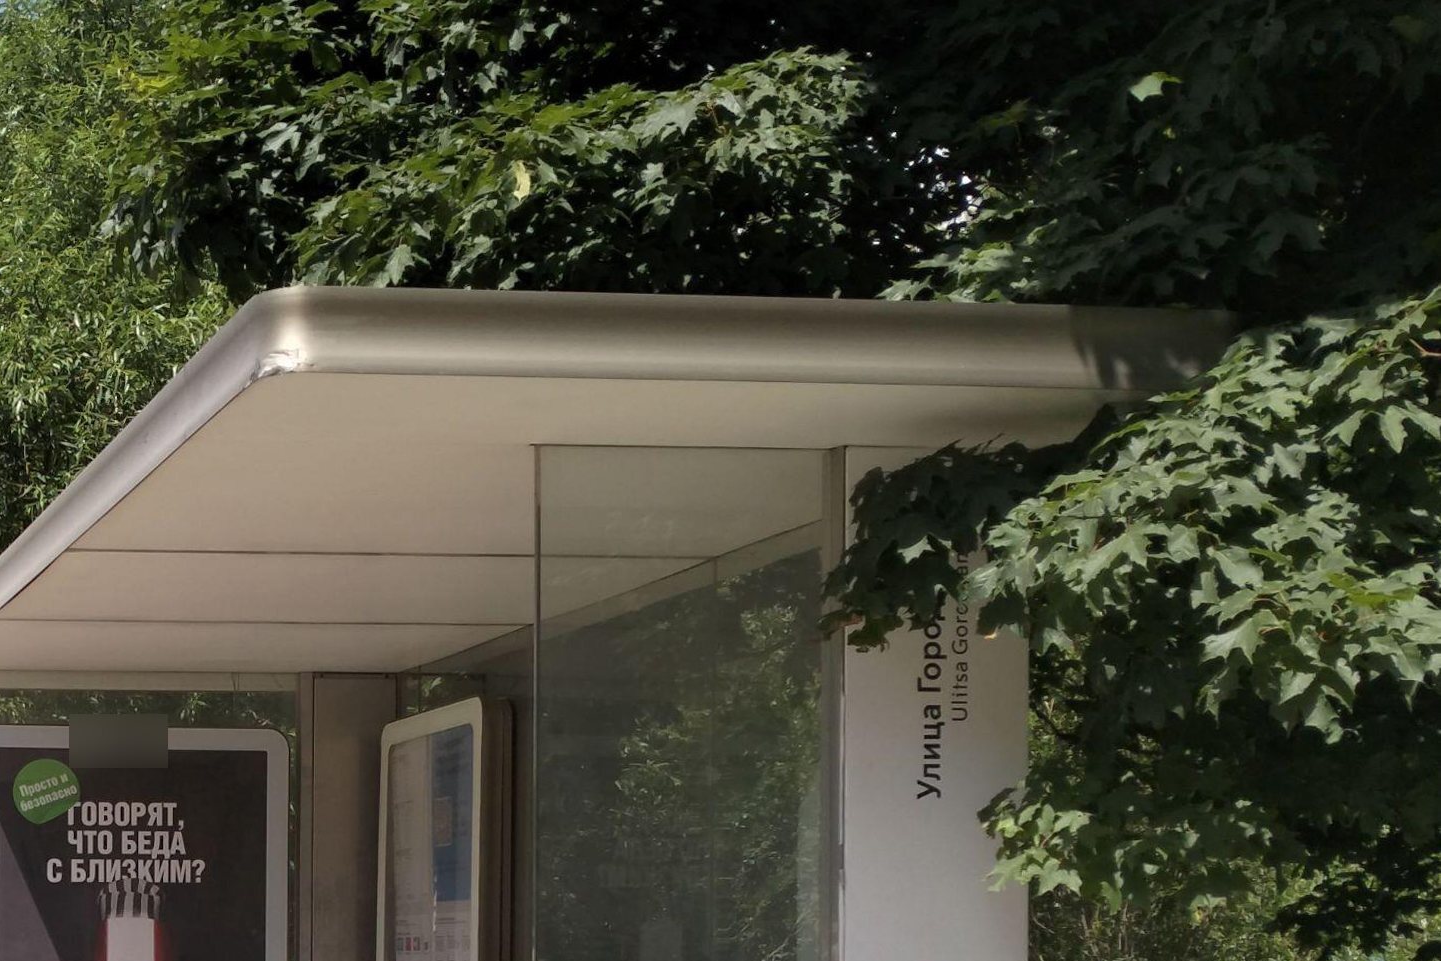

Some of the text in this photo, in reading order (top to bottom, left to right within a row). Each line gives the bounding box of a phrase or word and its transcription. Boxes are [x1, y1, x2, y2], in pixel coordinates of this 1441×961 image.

[951, 661, 969, 722] Ulitsa
[917, 704, 945, 799] Улица
[19, 773, 69, 797] Просто и
[20, 784, 78, 812] безопасно
[67, 801, 185, 830] ГОВОРЯТ,
[67, 830, 187, 859] ЧТО БЕДА
[46, 858, 206, 884] С БЛИЗКИМ?
